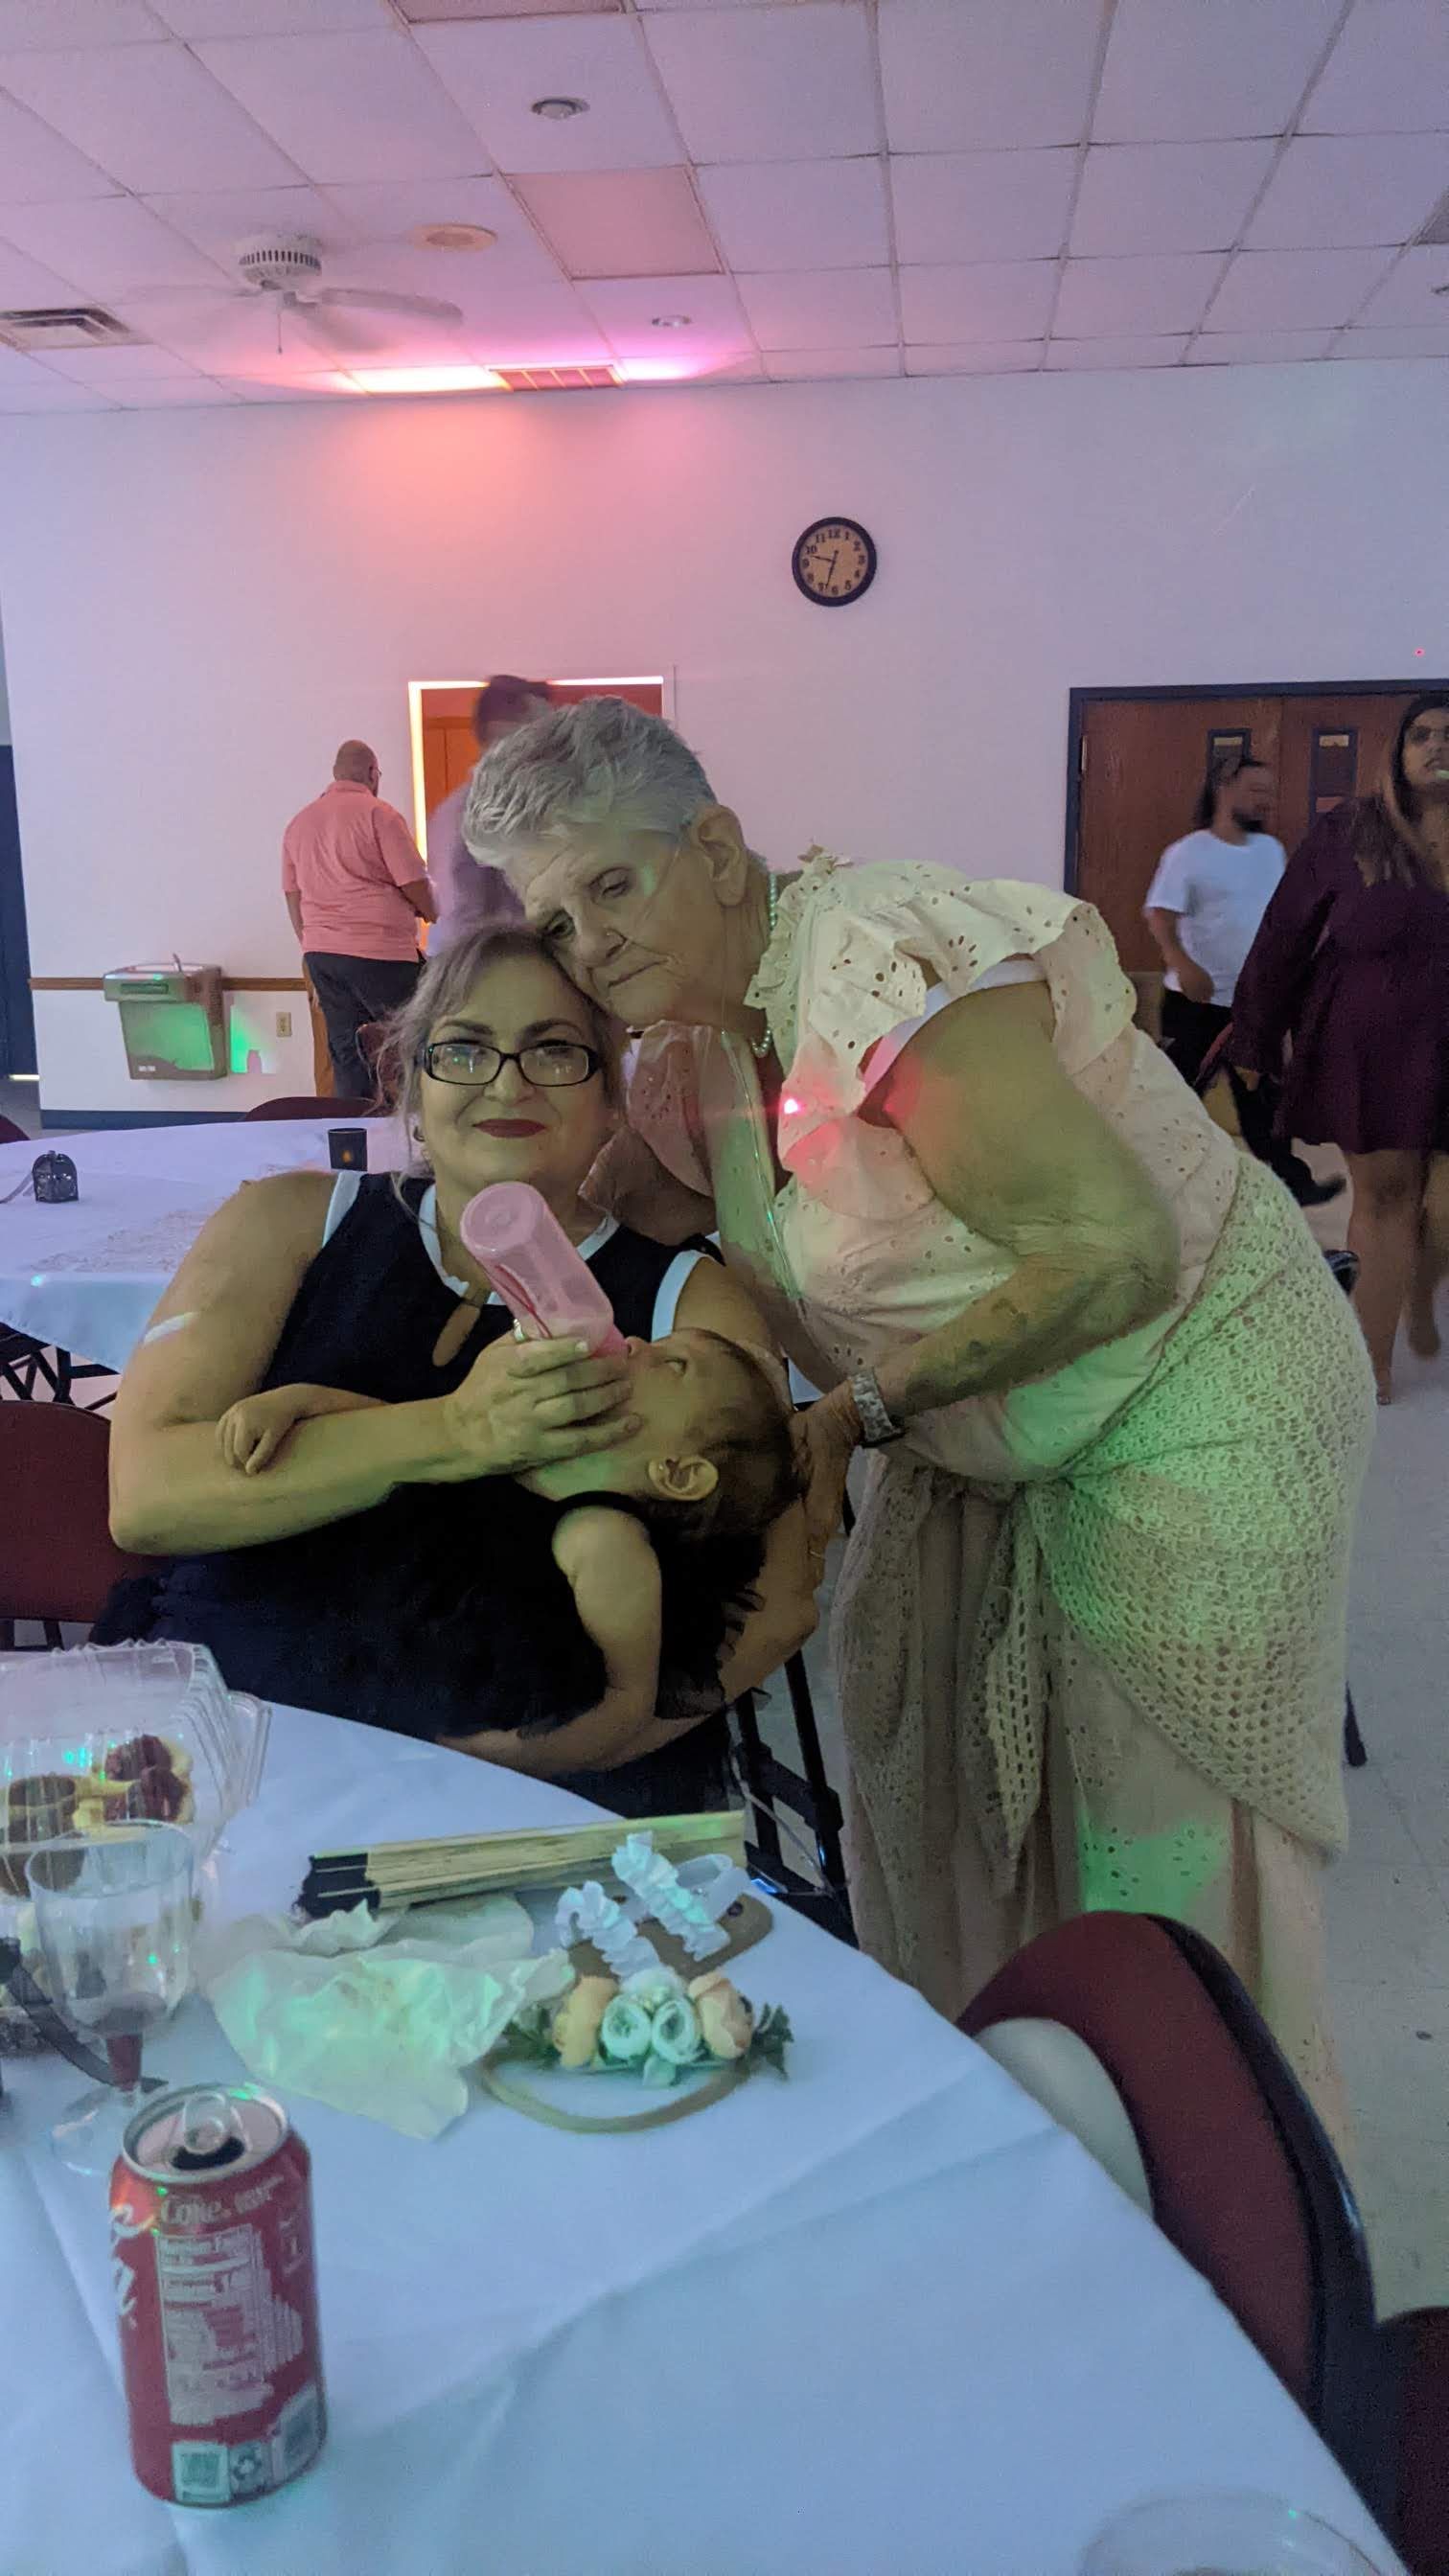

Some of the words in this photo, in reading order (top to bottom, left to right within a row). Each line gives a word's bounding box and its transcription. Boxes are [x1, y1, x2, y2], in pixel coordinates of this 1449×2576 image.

[816, 533, 825, 543] 11
[828, 528, 840, 539] 12
[845, 531, 850, 540] 1
[805, 545, 817, 555] 10
